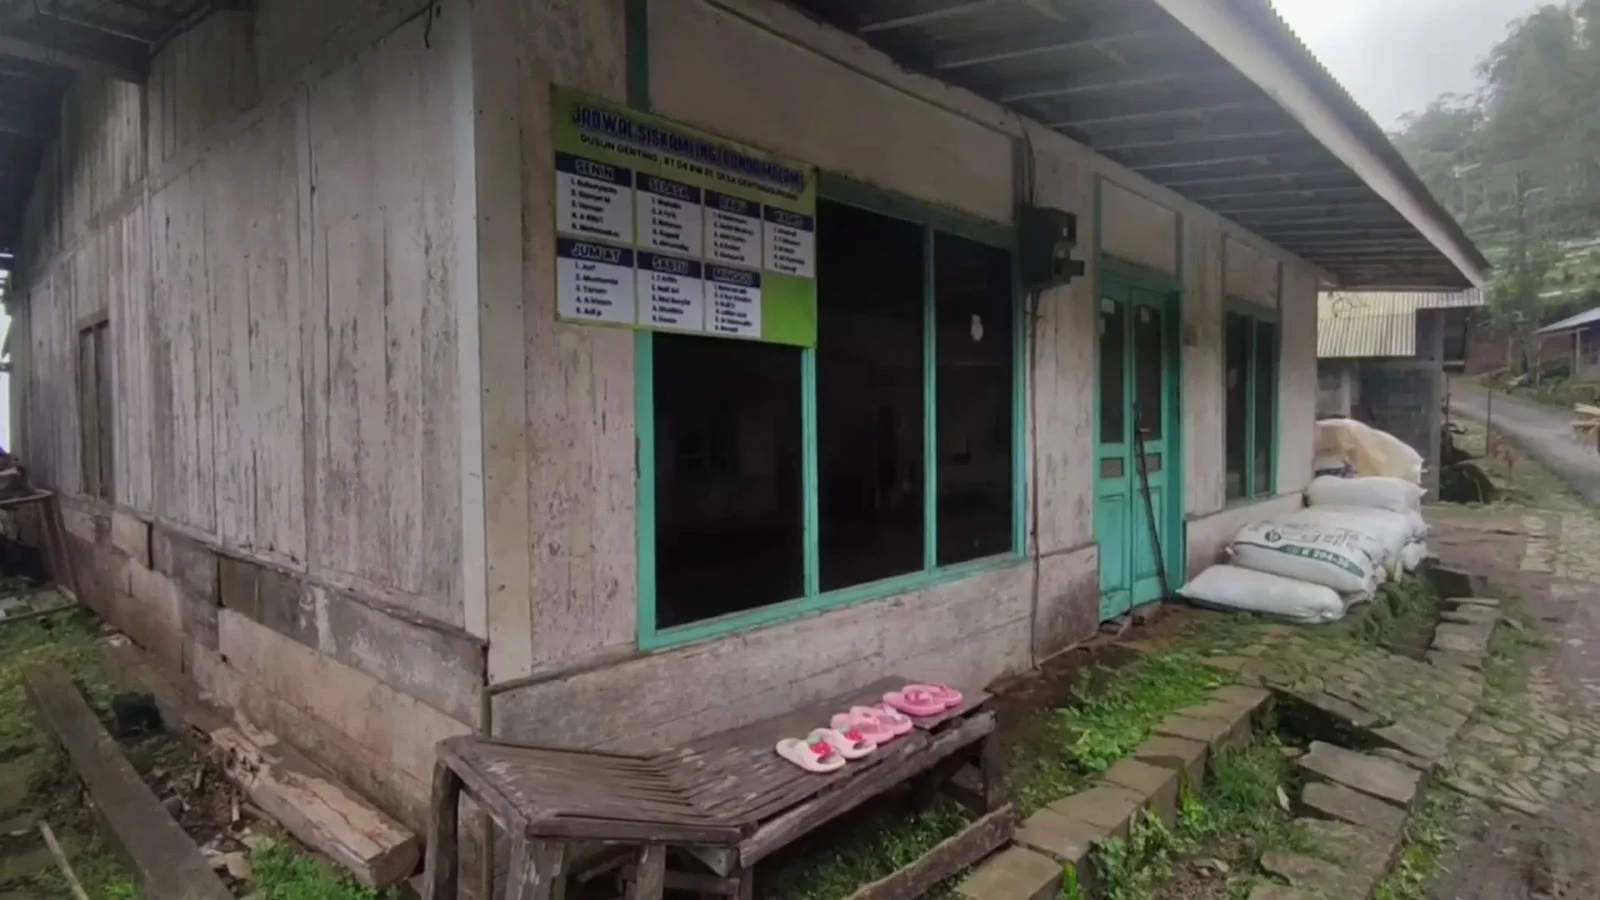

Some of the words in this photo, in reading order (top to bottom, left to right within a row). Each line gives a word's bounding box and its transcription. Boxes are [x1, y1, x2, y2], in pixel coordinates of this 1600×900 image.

[573, 105, 632, 138] JADWAL
[580, 134, 615, 151] DUSUN
[575, 159, 614, 181] SENIN
